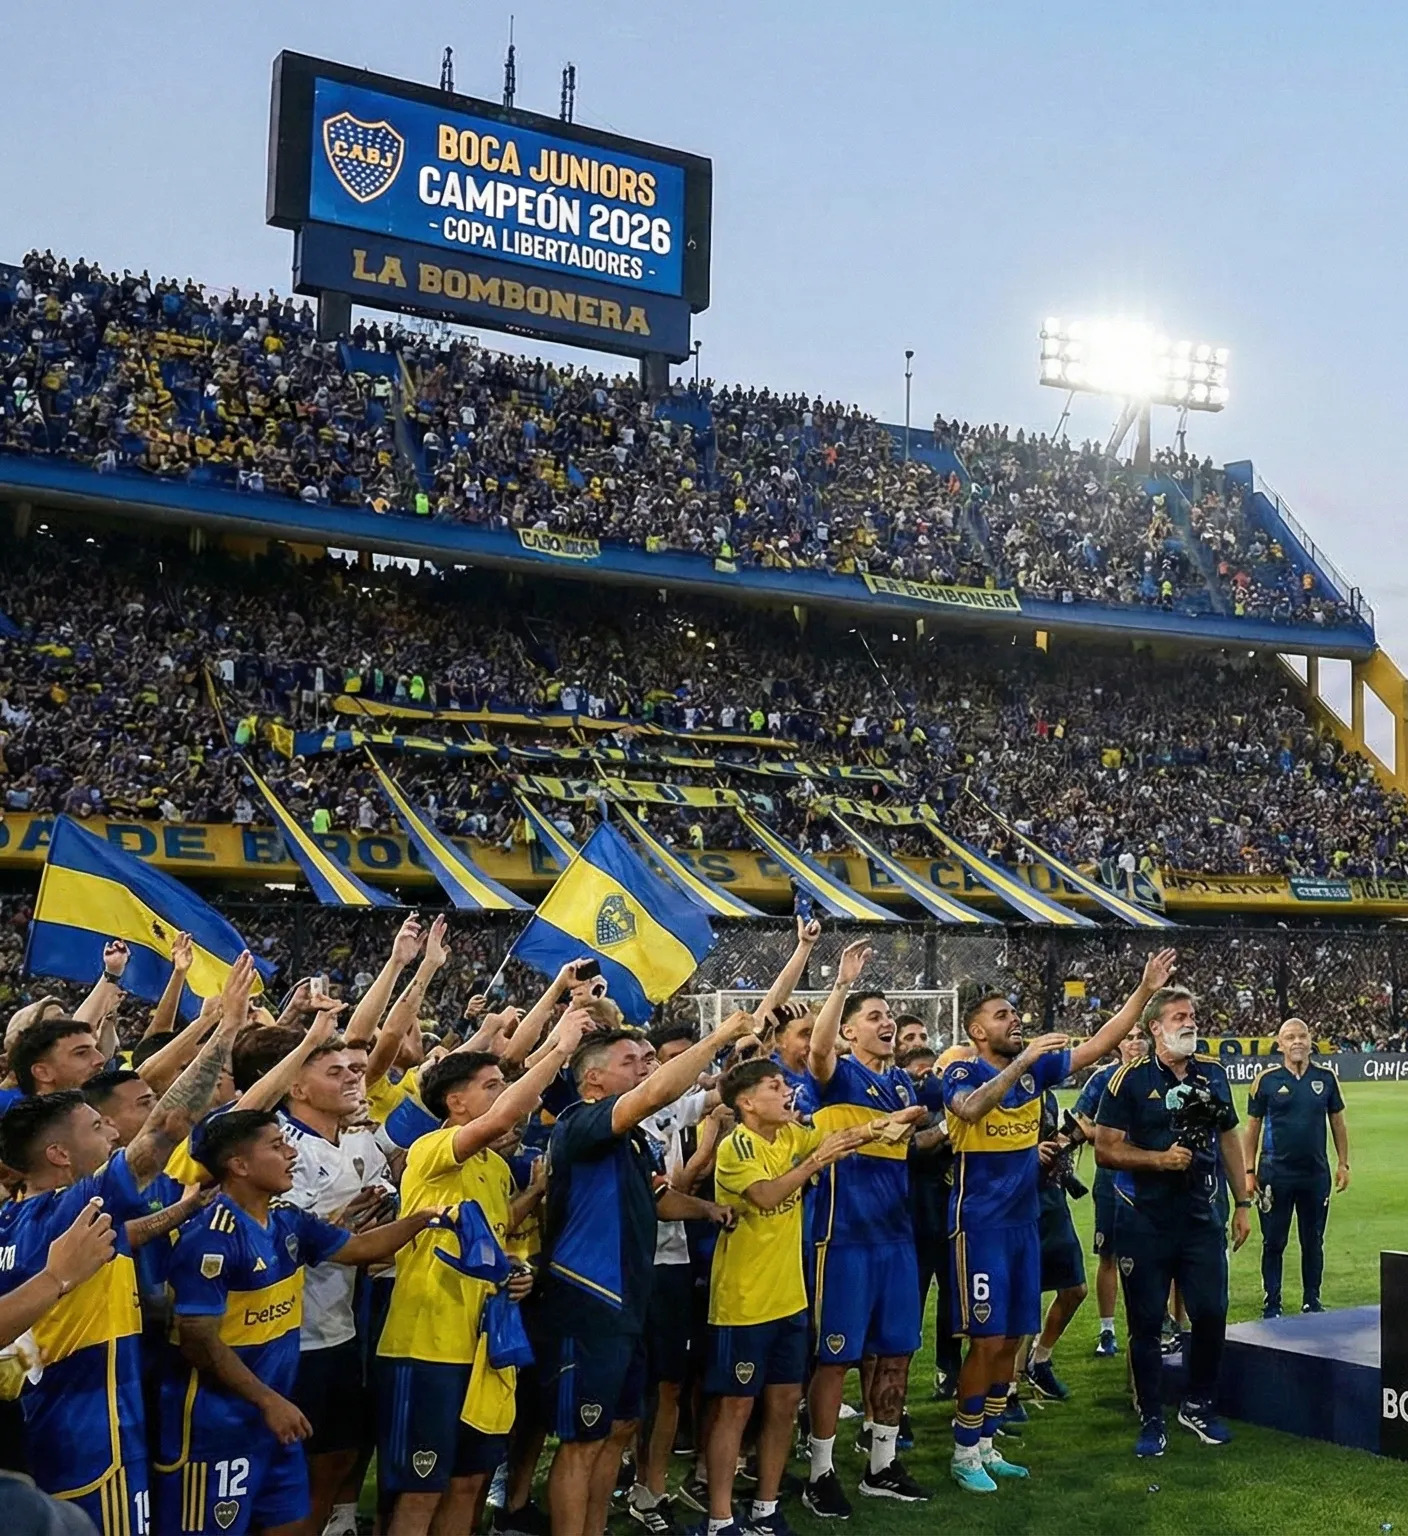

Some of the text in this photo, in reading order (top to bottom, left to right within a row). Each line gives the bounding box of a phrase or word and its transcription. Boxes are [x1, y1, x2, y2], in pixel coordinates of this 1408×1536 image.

[334, 140, 393, 167] CABJ
[437, 123, 656, 208] BOCA JUNIORS
[418, 165, 671, 255] CAMPEÓN 2026
[443, 216, 497, 249] COPA
[501, 228, 643, 280] LIBERTADORES
[352, 249, 652, 336] LA BOMBONERA
[973, 1273, 990, 1300] 6
[215, 1457, 250, 1497] 12
